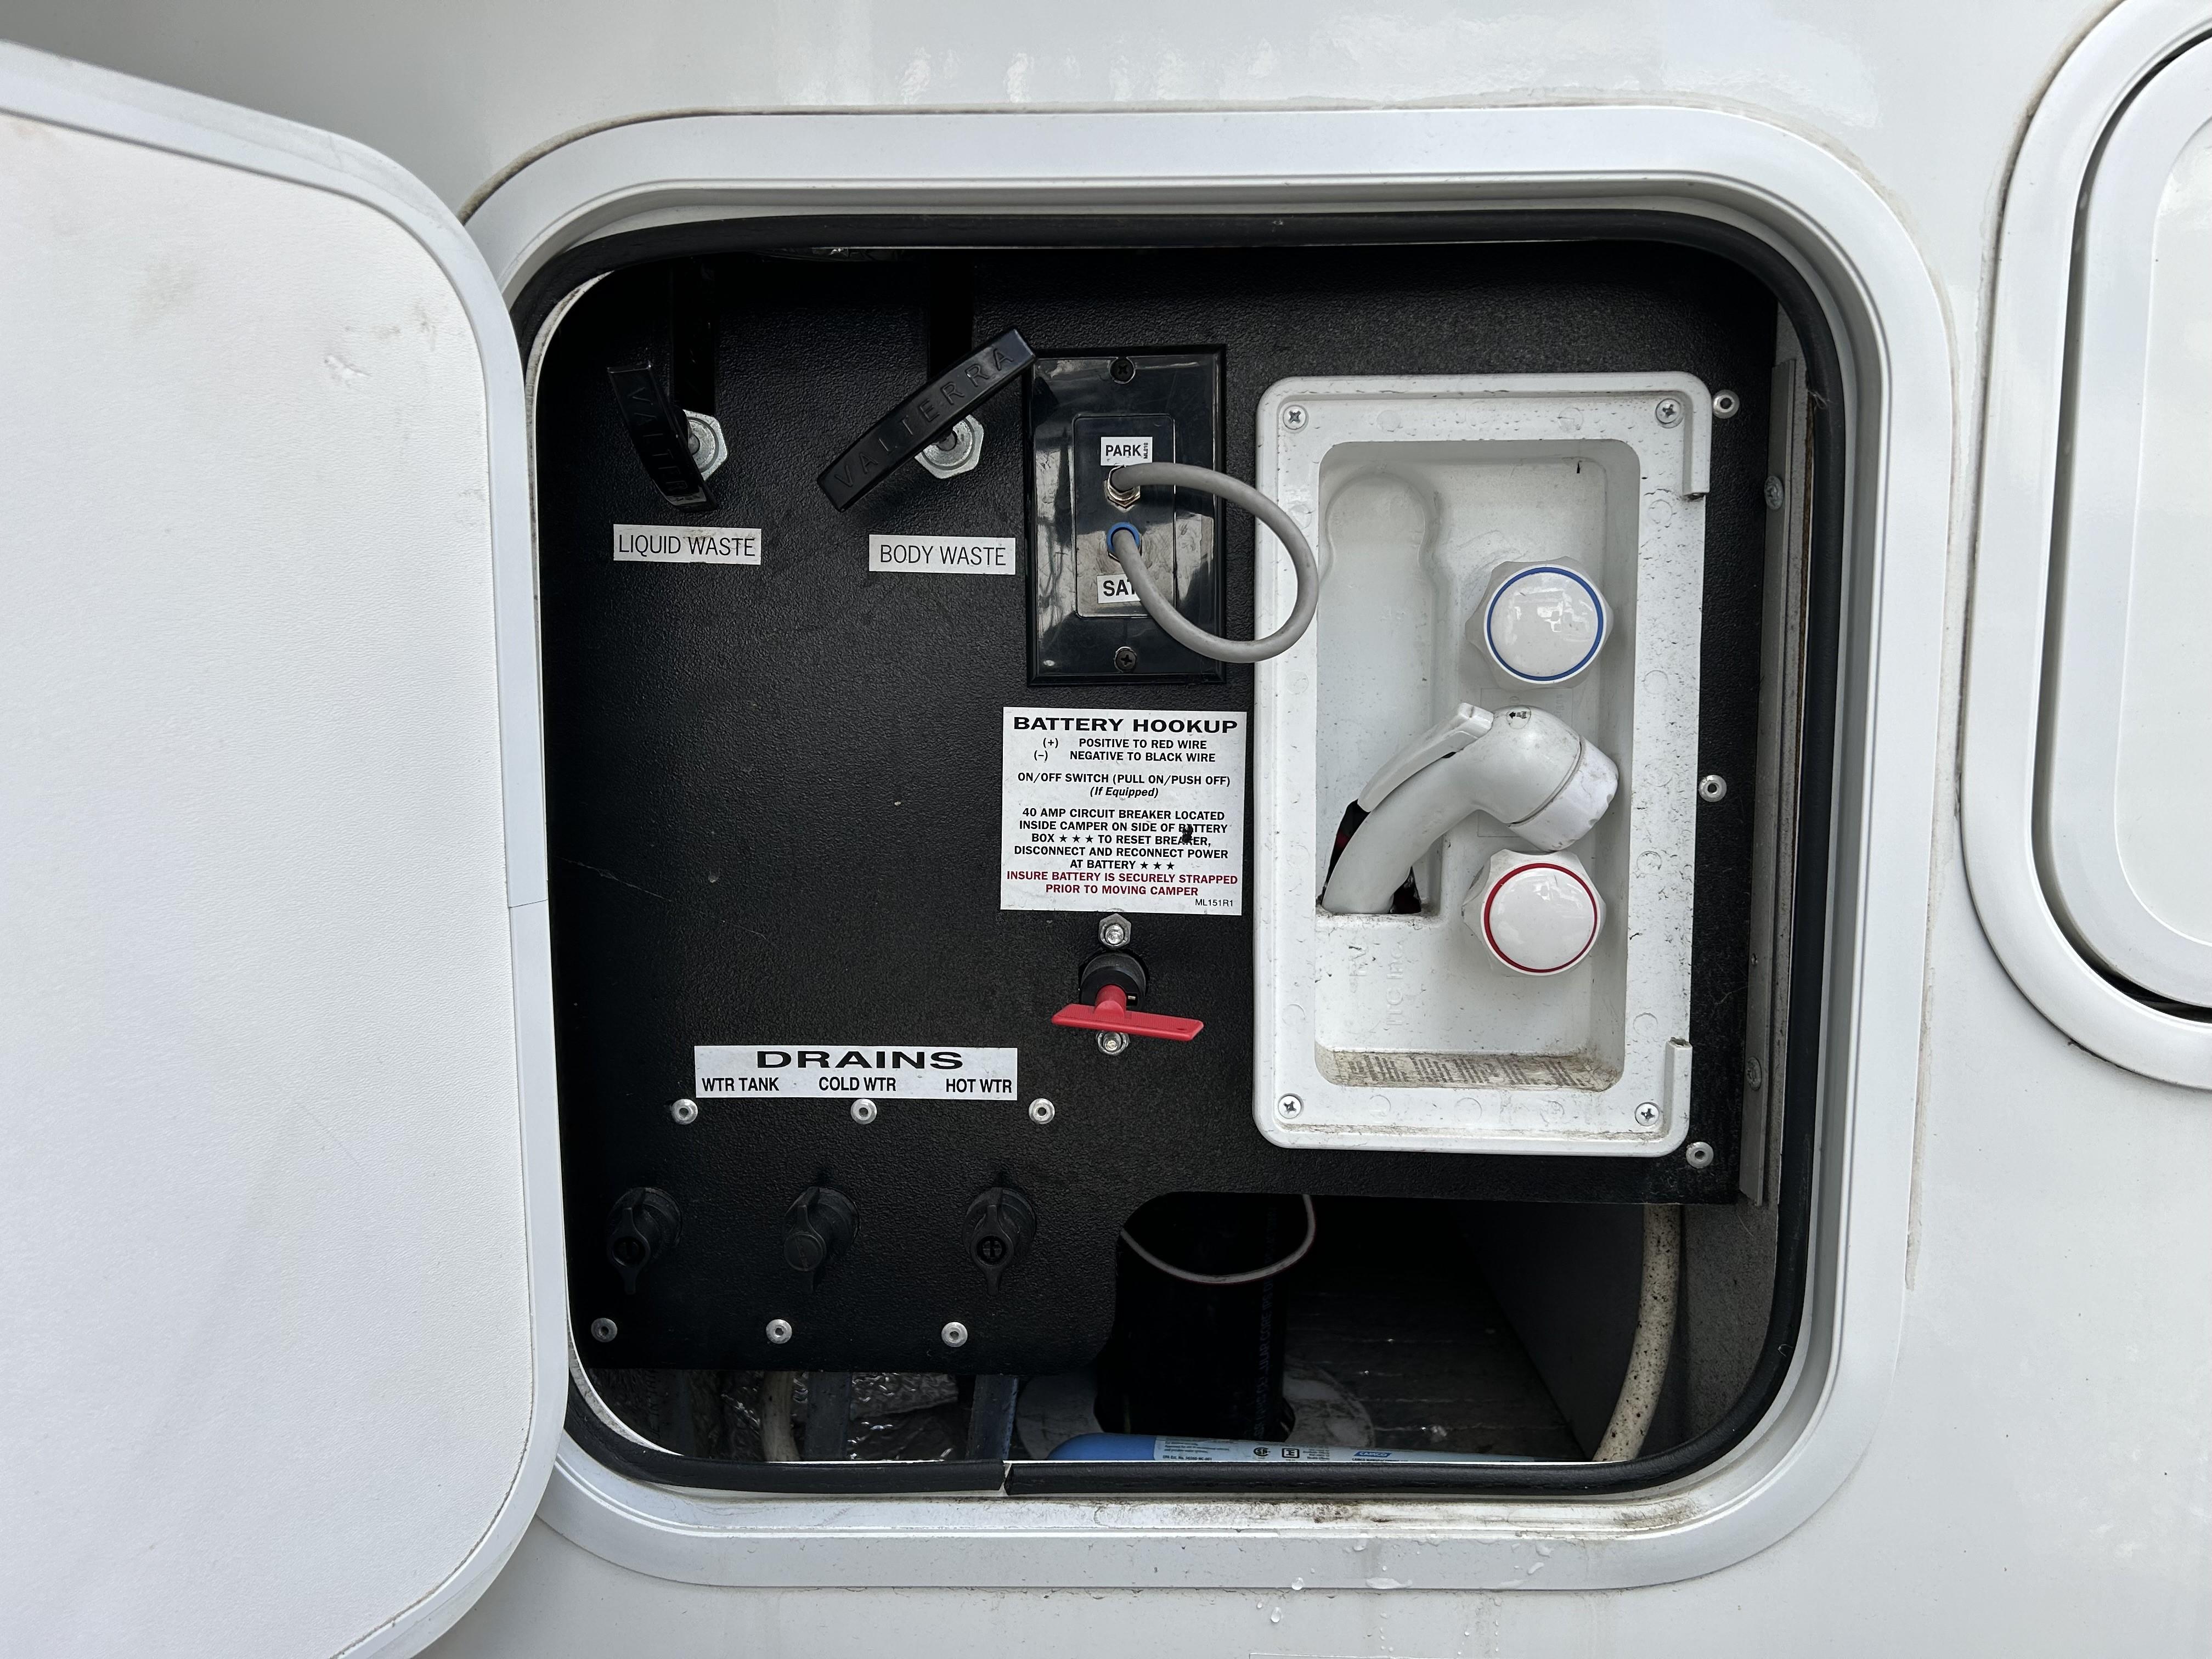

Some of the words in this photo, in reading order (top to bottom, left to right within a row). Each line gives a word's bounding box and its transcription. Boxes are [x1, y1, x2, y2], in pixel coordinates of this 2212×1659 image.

[834, 348, 1013, 488] VALTERRA
[1105, 444, 1142, 456] PARK
[619, 534, 681, 557] LIQUID
[687, 537, 755, 556] WASTE
[880, 545, 933, 564] BODY
[940, 546, 1006, 566] WASTE
[1014, 716, 1124, 731] BATTERY
[1133, 719, 1238, 733] HOOKUP
[1079, 738, 1129, 748] POSITIVE
[1133, 739, 1147, 748] TO
[1152, 740, 1173, 749] RED
[1177, 740, 1207, 749] WIRE
[1070, 751, 1124, 760] NEGATIVE
[1127, 752, 1142, 761] TO
[1146, 752, 1182, 762] BLACK
[1186, 753, 1216, 762] WIRE
[1018, 772, 1062, 783] ON/OFF
[1065, 773, 1109, 783] SWITCH
[1113, 774, 1145, 785] (PULL
[1148, 775, 1201, 786] ON/PUSH
[1205, 776, 1230, 787] OFF)
[1090, 786, 1103, 797] (If
[1105, 787, 1159, 798] Equipped)
[1022, 808, 1037, 817] 40
[1040, 808, 1066, 817] AMP
[1069, 809, 1115, 818] CIRCUIT
[1119, 809, 1171, 819] BREAKER
[1175, 810, 1225, 820] LOCATED
[1019, 820, 1057, 830] INSIDE
[1060, 821, 1108, 831] CAMPER
[1111, 822, 1127, 831] ON
[1131, 822, 1157, 832] SIDE
[1160, 823, 1175, 832] OF
[1178, 823, 1228, 833] BTTERY
[1031, 833, 1055, 842] BOX
[1098, 834, 1112, 844] TO
[1116, 835, 1151, 844] RESET
[1014, 845, 1086, 856] DISCONNECT
[1089, 847, 1113, 856] AND
[1116, 848, 1184, 857] RECONNECT
[1187, 849, 1228, 859] POWER
[1070, 859, 1084, 868] AT
[1087, 860, 1136, 870] BATTERY
[1007, 871, 1048, 881] INSURE
[1052, 872, 1101, 881] BATTERY
[1104, 872, 1115, 882] IS
[1119, 873, 1176, 883] SECURELY
[1178, 874, 1238, 884] STRAPPED
[1046, 884, 1080, 893] PRIOR
[1084, 885, 1098, 894] TO
[1102, 885, 1146, 895] MOVING
[1150, 887, 1198, 896] CAMPER
[1195, 899, 1233, 907] ML151R1
[757, 1050, 963, 1070] DRAINS
[702, 1077, 735, 1092] WTR
[738, 1077, 779, 1092] TANK
[819, 1076, 860, 1091] COLD
[864, 1077, 896, 1092] WTR
[946, 1079, 976, 1093] HOT
[980, 1079, 1012, 1093] WTR
